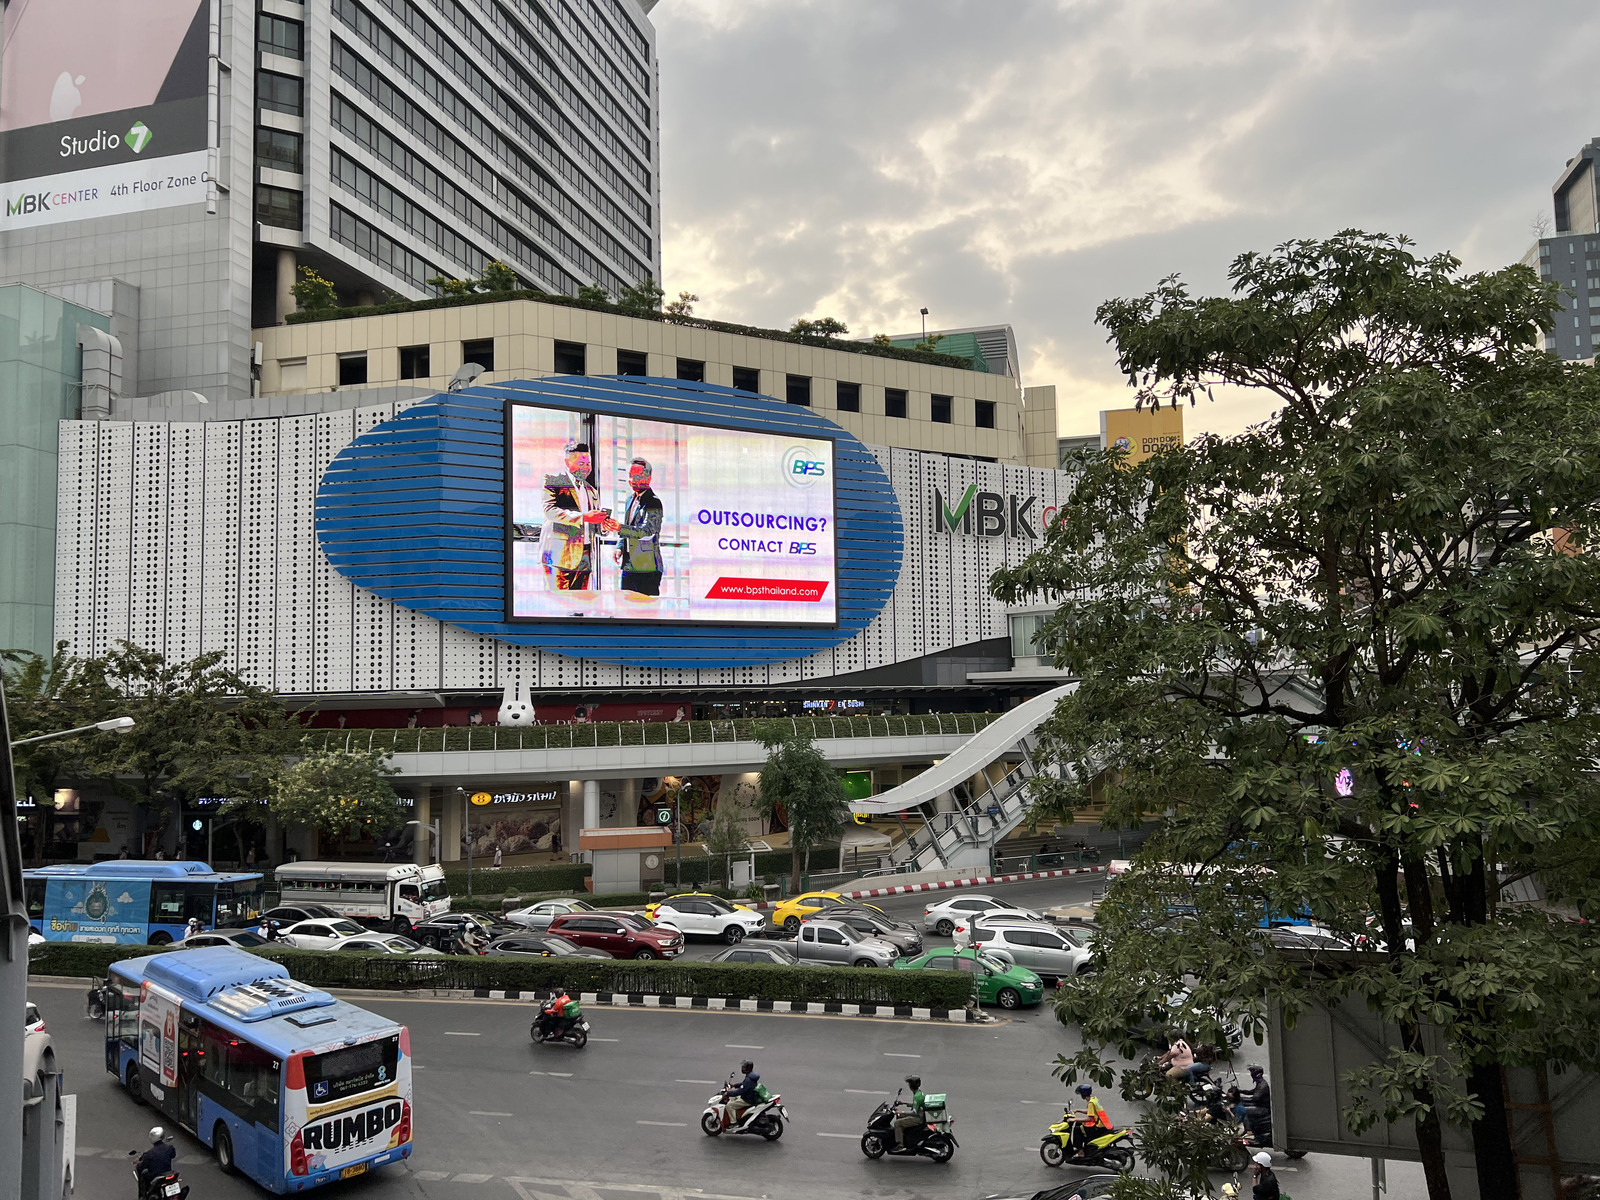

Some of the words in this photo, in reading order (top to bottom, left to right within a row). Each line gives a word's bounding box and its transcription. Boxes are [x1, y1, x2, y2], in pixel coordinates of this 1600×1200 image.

[60, 129, 120, 157] Studio
[6, 191, 51, 217] MBK
[52, 188, 98, 206] CENTER
[110, 184, 128, 197] 4th
[133, 179, 163, 194] Floor
[167, 175, 197, 189] Zone
[1142, 436, 1159, 444] DON
[792, 459, 825, 477] BPS
[697, 508, 828, 532] OUTSOURCING?
[934, 483, 1039, 540] MBK
[718, 537, 783, 553] CONTACT
[789, 541, 817, 555] BPS
[720, 585, 819, 597] www.bpsthailand.com
[303, 1101, 401, 1150] RUMBO
